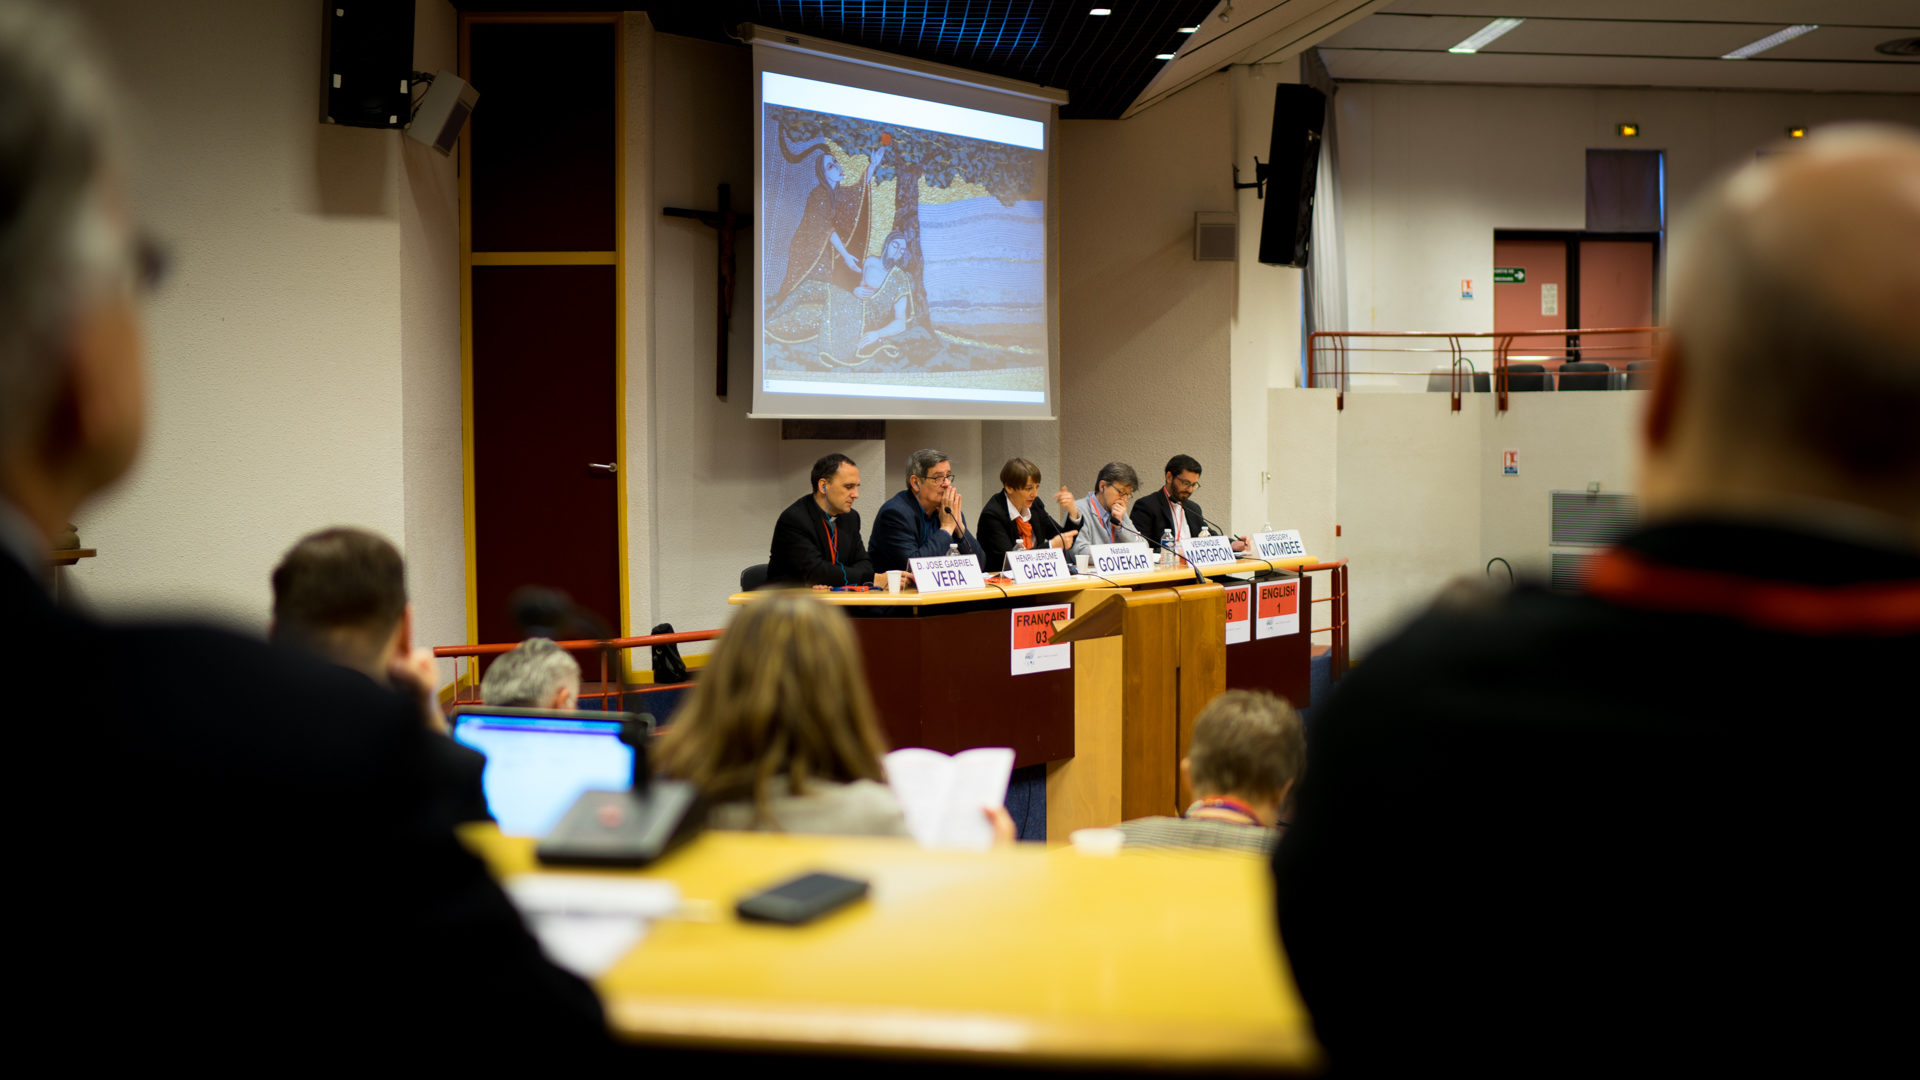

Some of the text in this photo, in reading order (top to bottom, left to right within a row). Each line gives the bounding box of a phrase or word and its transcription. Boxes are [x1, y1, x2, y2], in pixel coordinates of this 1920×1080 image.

[1186, 547, 1234, 563] MARGRON
[1259, 541, 1302, 556] WOIMBEE
[916, 558, 974, 570] D. JOSE GABRIEL
[1023, 561, 1058, 579] GAGEY
[1098, 554, 1149, 572] GOVEKAR
[932, 569, 968, 587] VERA
[1226, 590, 1247, 604] IANO
[1262, 585, 1296, 600] ENGLISH
[1225, 608, 1233, 620] 6
[1276, 602, 1281, 614] 1
[1016, 611, 1066, 627] FRANÇAIS
[1036, 630, 1048, 644] 03
